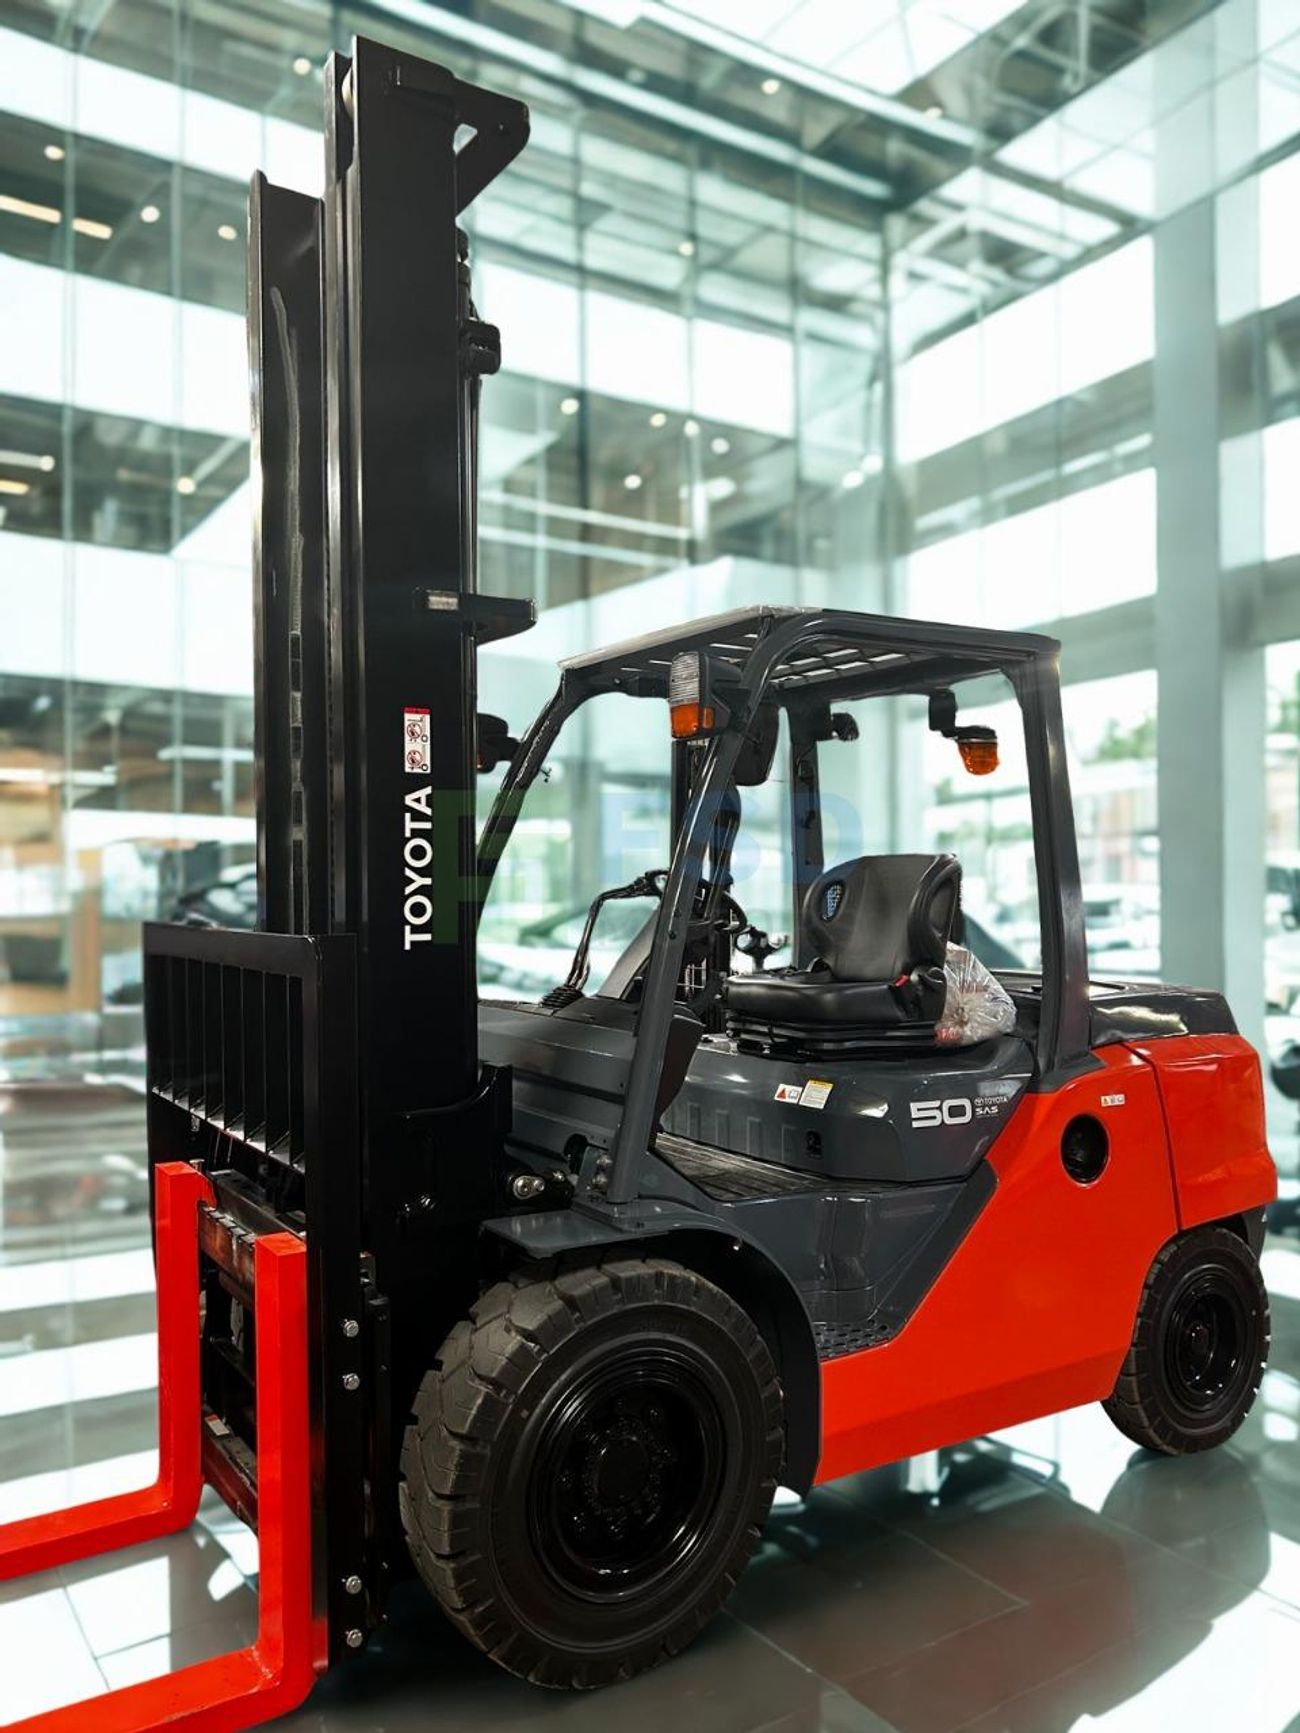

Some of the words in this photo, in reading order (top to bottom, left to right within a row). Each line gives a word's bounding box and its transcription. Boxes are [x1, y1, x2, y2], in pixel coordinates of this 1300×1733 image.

[404, 786, 433, 950] TOYOTA
[910, 1098, 972, 1128] 50
[975, 1105, 999, 1115] SAS
